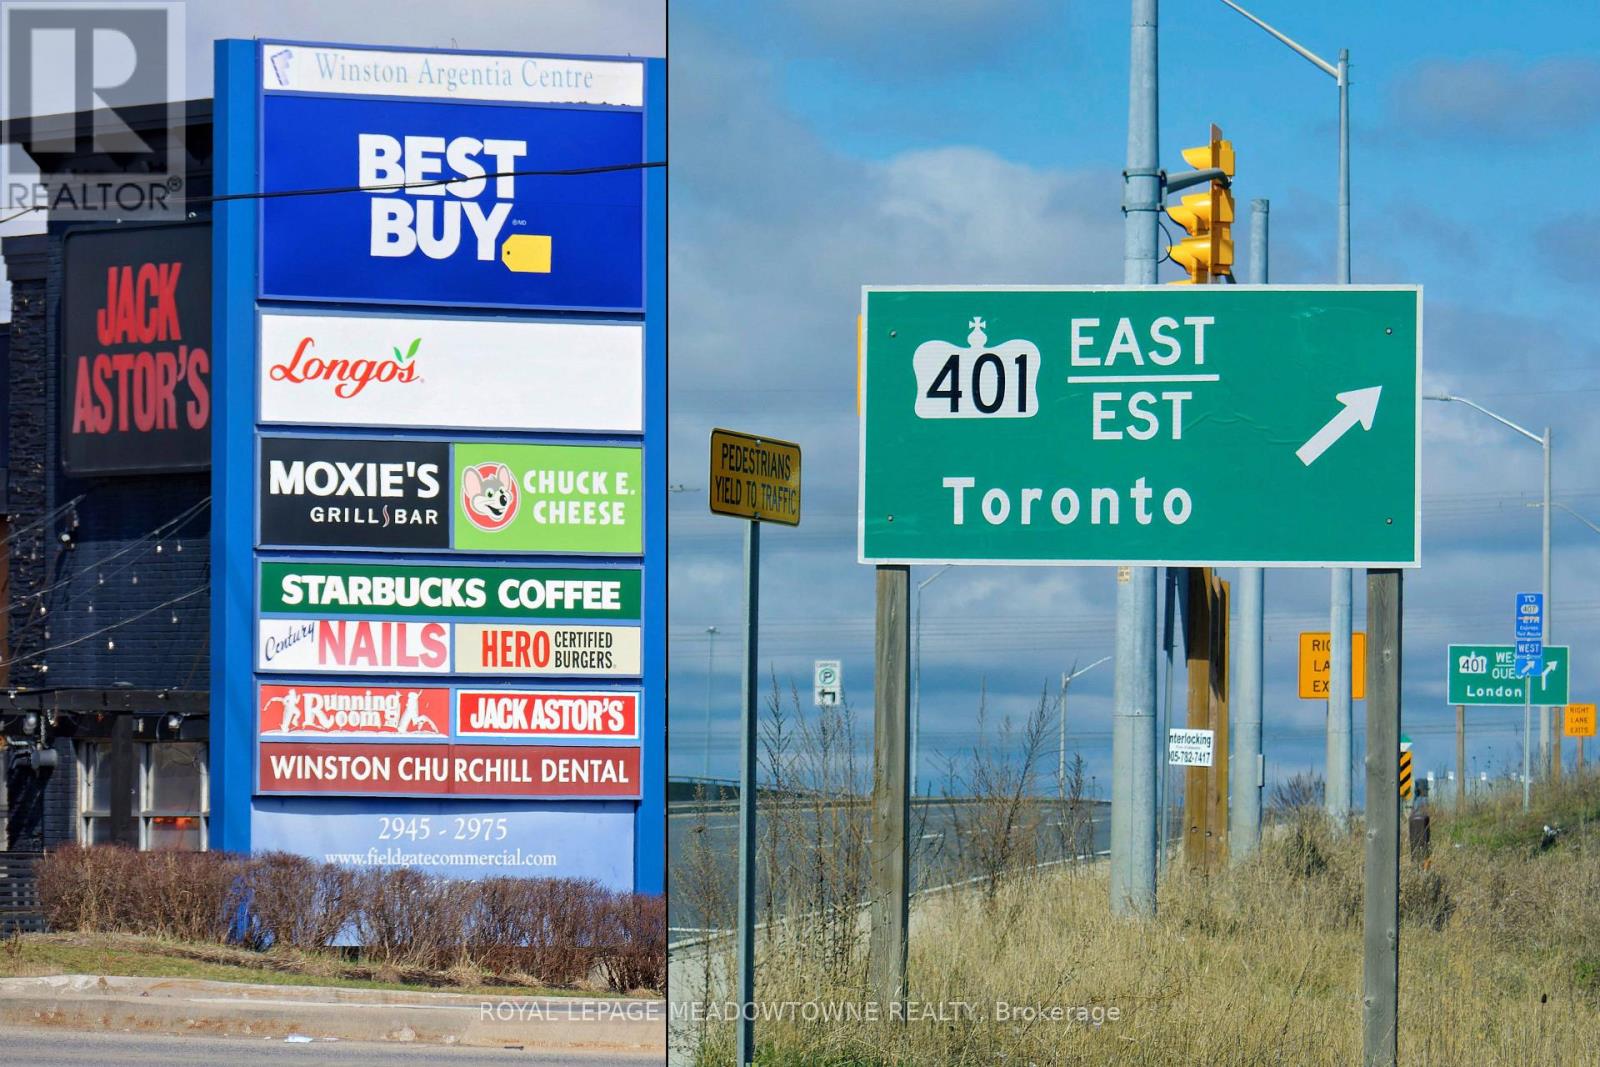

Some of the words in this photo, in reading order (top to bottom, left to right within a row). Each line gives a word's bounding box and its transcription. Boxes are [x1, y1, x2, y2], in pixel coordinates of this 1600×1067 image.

[314, 52, 409, 84] Winston
[418, 58, 512, 92] Argentia
[521, 61, 594, 90] Centre
[358, 133, 527, 199] BEST
[370, 197, 514, 261] BUY
[97, 262, 182, 346] JACK
[1071, 316, 1215, 367] EAST
[72, 345, 210, 434] ASTOR'S
[926, 353, 1027, 414] 401
[1092, 391, 1193, 440] EST
[269, 460, 440, 499] MOXIE'S
[721, 443, 791, 481] PEDESTRIANS
[523, 470, 609, 495] CHUCK
[616, 472, 636, 496] E.
[715, 475, 742, 505] YIELD
[746, 480, 757, 509] TO
[761, 483, 797, 515] TRAFFIC
[943, 476, 1192, 525] Toronto
[310, 506, 382, 525] GRILL
[394, 508, 438, 525] BAR
[533, 501, 626, 525] CHEESE
[281, 574, 486, 609] STARBUCKS
[498, 578, 621, 610] COFFEE
[265, 621, 316, 662] Century
[318, 620, 448, 668] NAILS
[482, 630, 550, 668] HERO
[554, 631, 613, 648] CERTIFIED
[1495, 651, 1515, 663] WE
[1518, 643, 1540, 653] WEST
[1461, 659, 1485, 673] 401
[1492, 667, 1524, 679] OUE
[303, 690, 401, 728] Running
[1467, 685, 1522, 698] London
[470, 697, 528, 730] JACK
[530, 698, 625, 732] ASTOR'S
[270, 755, 391, 781] WINSTON
[397, 755, 532, 783] CHURCHILL
[541, 758, 629, 783] DENTAL
[378, 817, 431, 842] 2945
[454, 817, 508, 842] 2975
[325, 847, 557, 871] www.fieldgatecommercial.com
